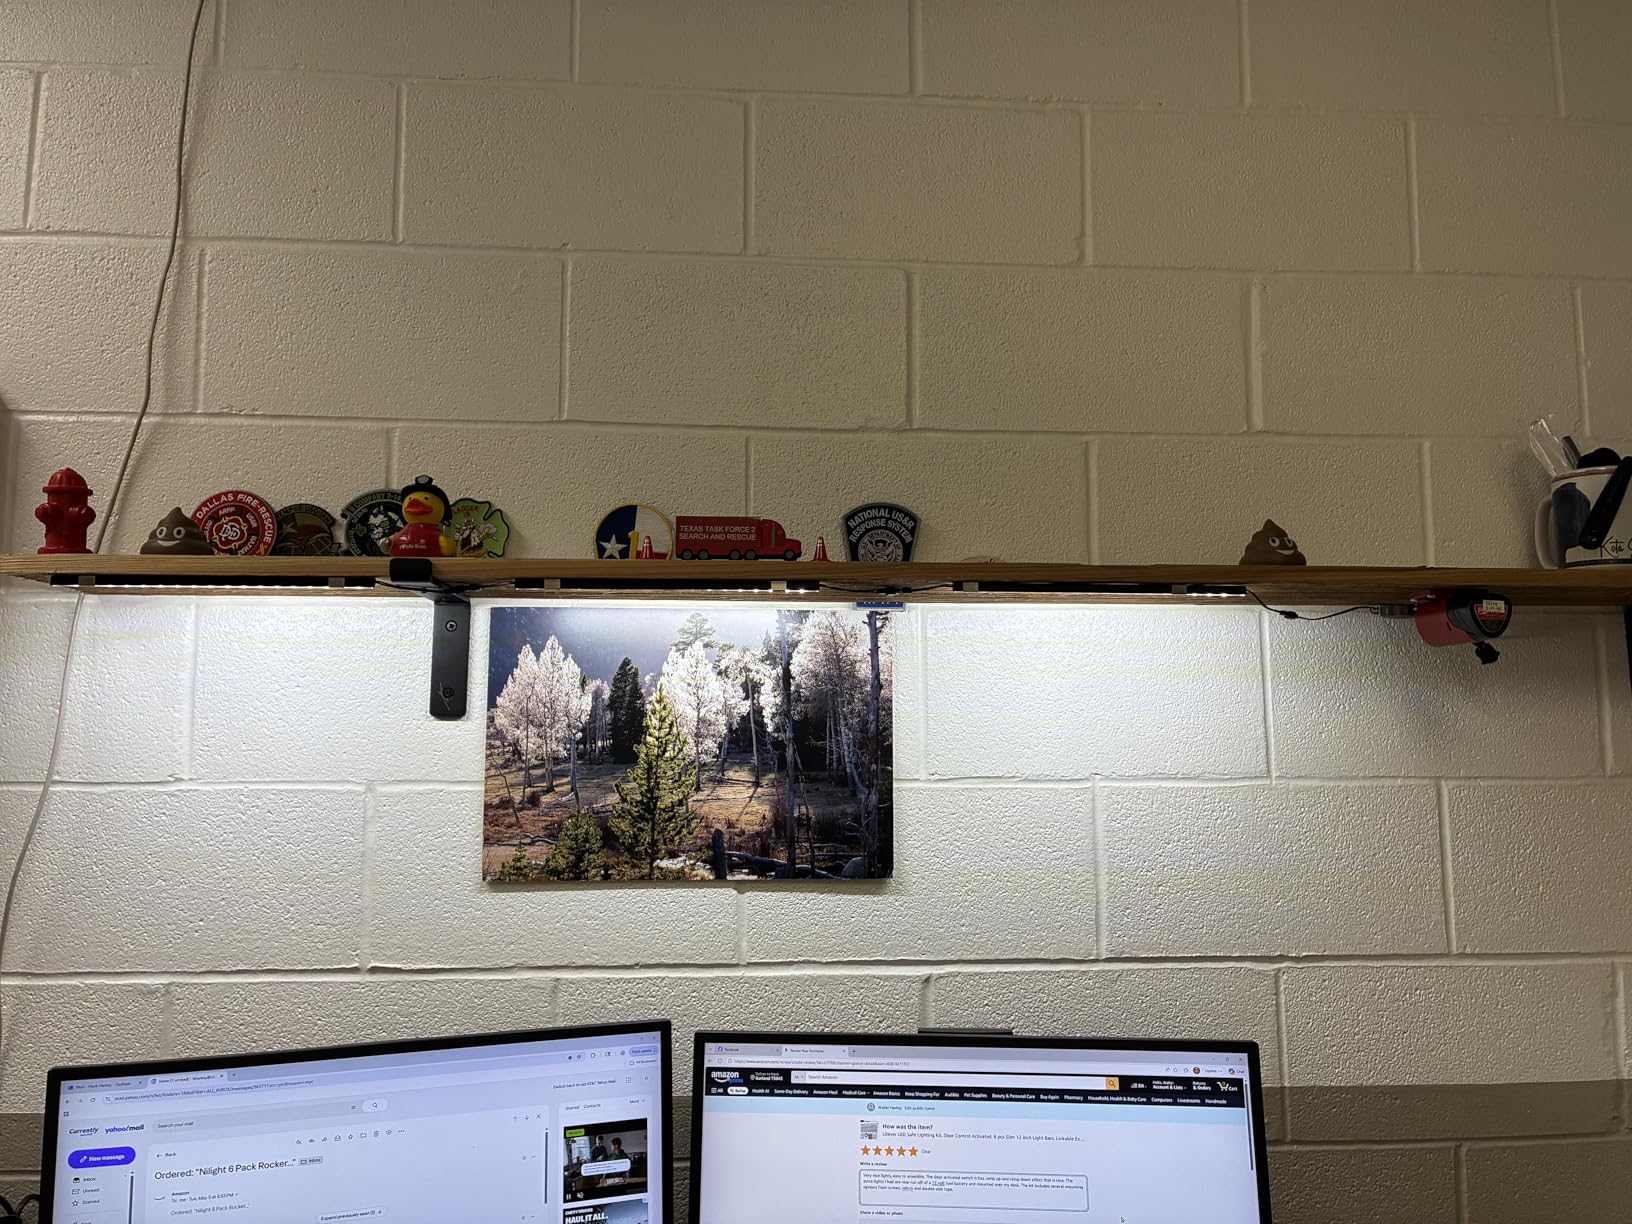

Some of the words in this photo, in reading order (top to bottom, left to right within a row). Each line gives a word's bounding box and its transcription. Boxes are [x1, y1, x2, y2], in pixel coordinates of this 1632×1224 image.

[354, 493, 385, 508] COMPANY
[196, 494, 234, 519] DALLAS
[237, 494, 274, 543] FIRE-RESCUE
[848, 508, 890, 529] NATIONAL
[891, 510, 915, 529] US&R
[849, 518, 886, 542] RESPONSE
[887, 520, 913, 543] SYSTEM
[1601, 537, 1624, 558] Kota
[69, 1127, 98, 1135] Currently
[155, 1169, 193, 1179] Ordered:
[195, 1166, 226, 1177] "Nilight
[228, 1165, 234, 1173] 6
[236, 1163, 257, 1172] Pack
[565, 1215, 585, 1224] HAUL
[584, 1214, 592, 1222] IT
[592, 1212, 608, 1221] ALL.
